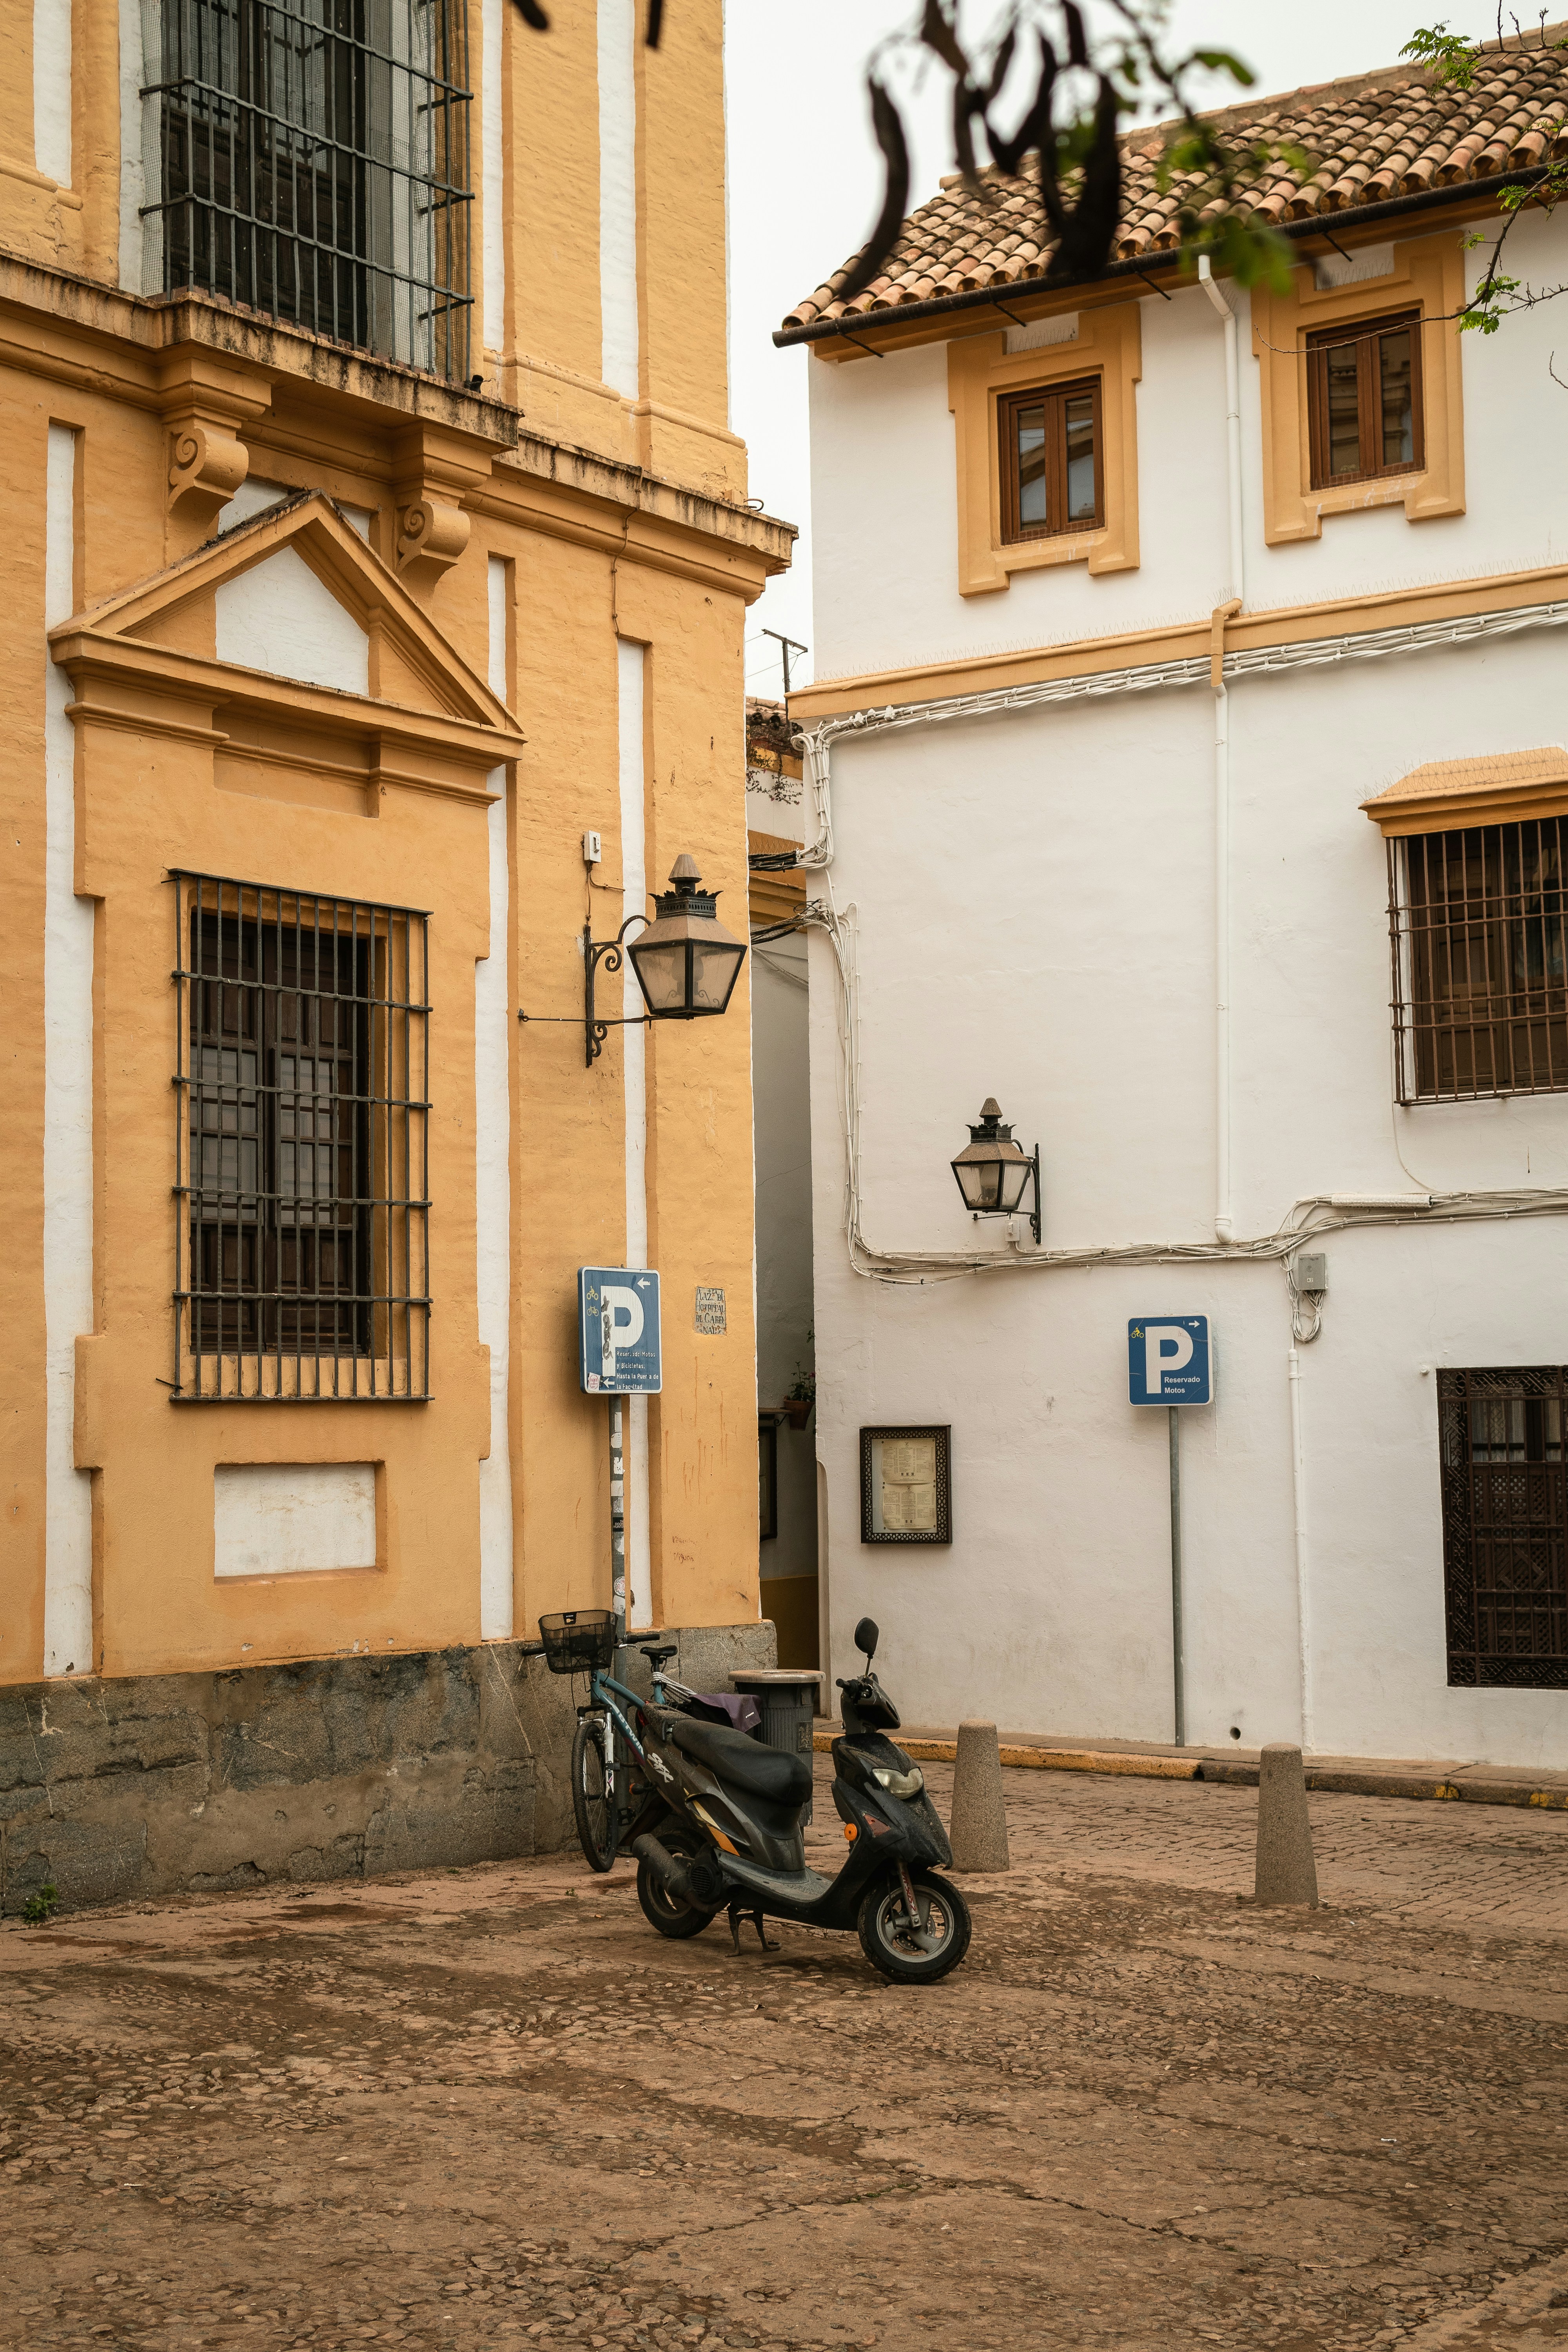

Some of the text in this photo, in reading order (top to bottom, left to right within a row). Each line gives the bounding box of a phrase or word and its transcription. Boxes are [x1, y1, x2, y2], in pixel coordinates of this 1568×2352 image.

[601, 1285, 644, 1377] P
[696, 1300, 725, 1313] HOSPITAL
[1145, 1326, 1193, 1394] P
